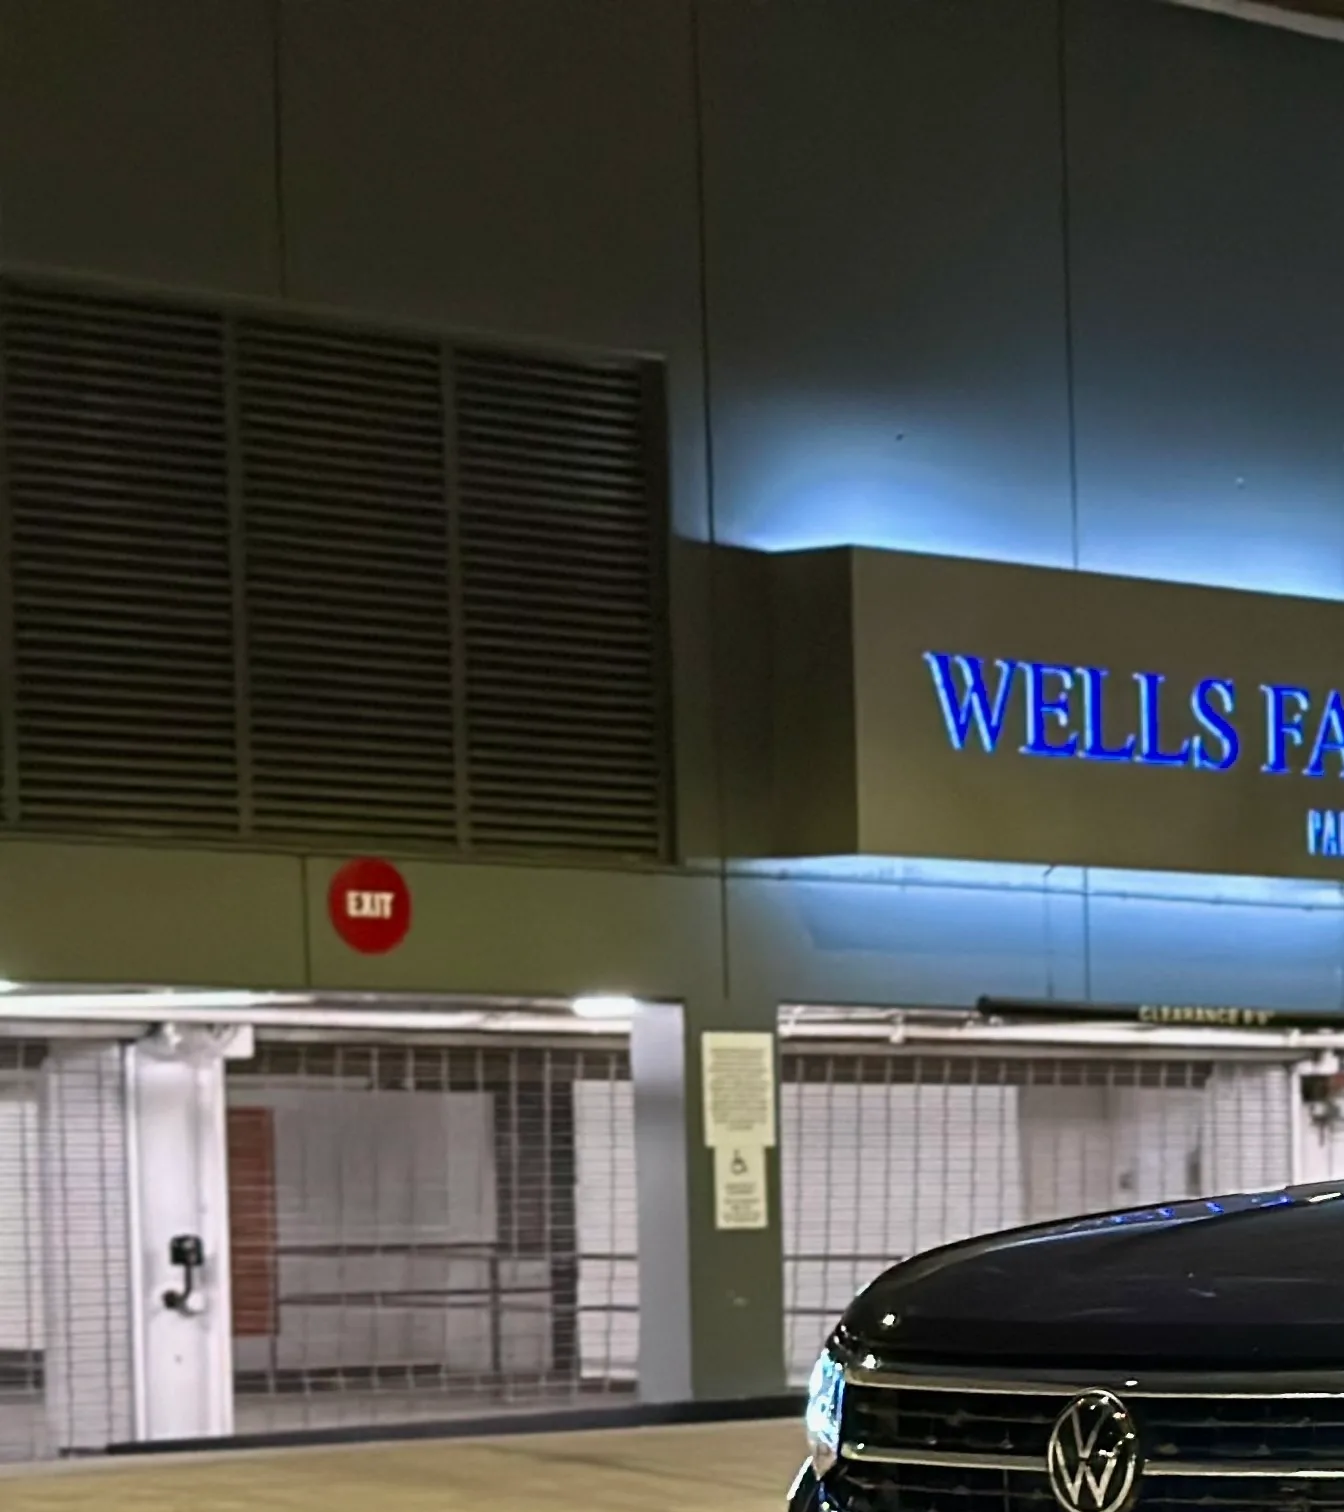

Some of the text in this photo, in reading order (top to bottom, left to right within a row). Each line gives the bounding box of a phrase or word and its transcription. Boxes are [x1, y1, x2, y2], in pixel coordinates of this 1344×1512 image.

[922, 651, 1239, 771] WELLS
[346, 889, 395, 920] EXIT
[1138, 1003, 1239, 1025] CLEARANCE
